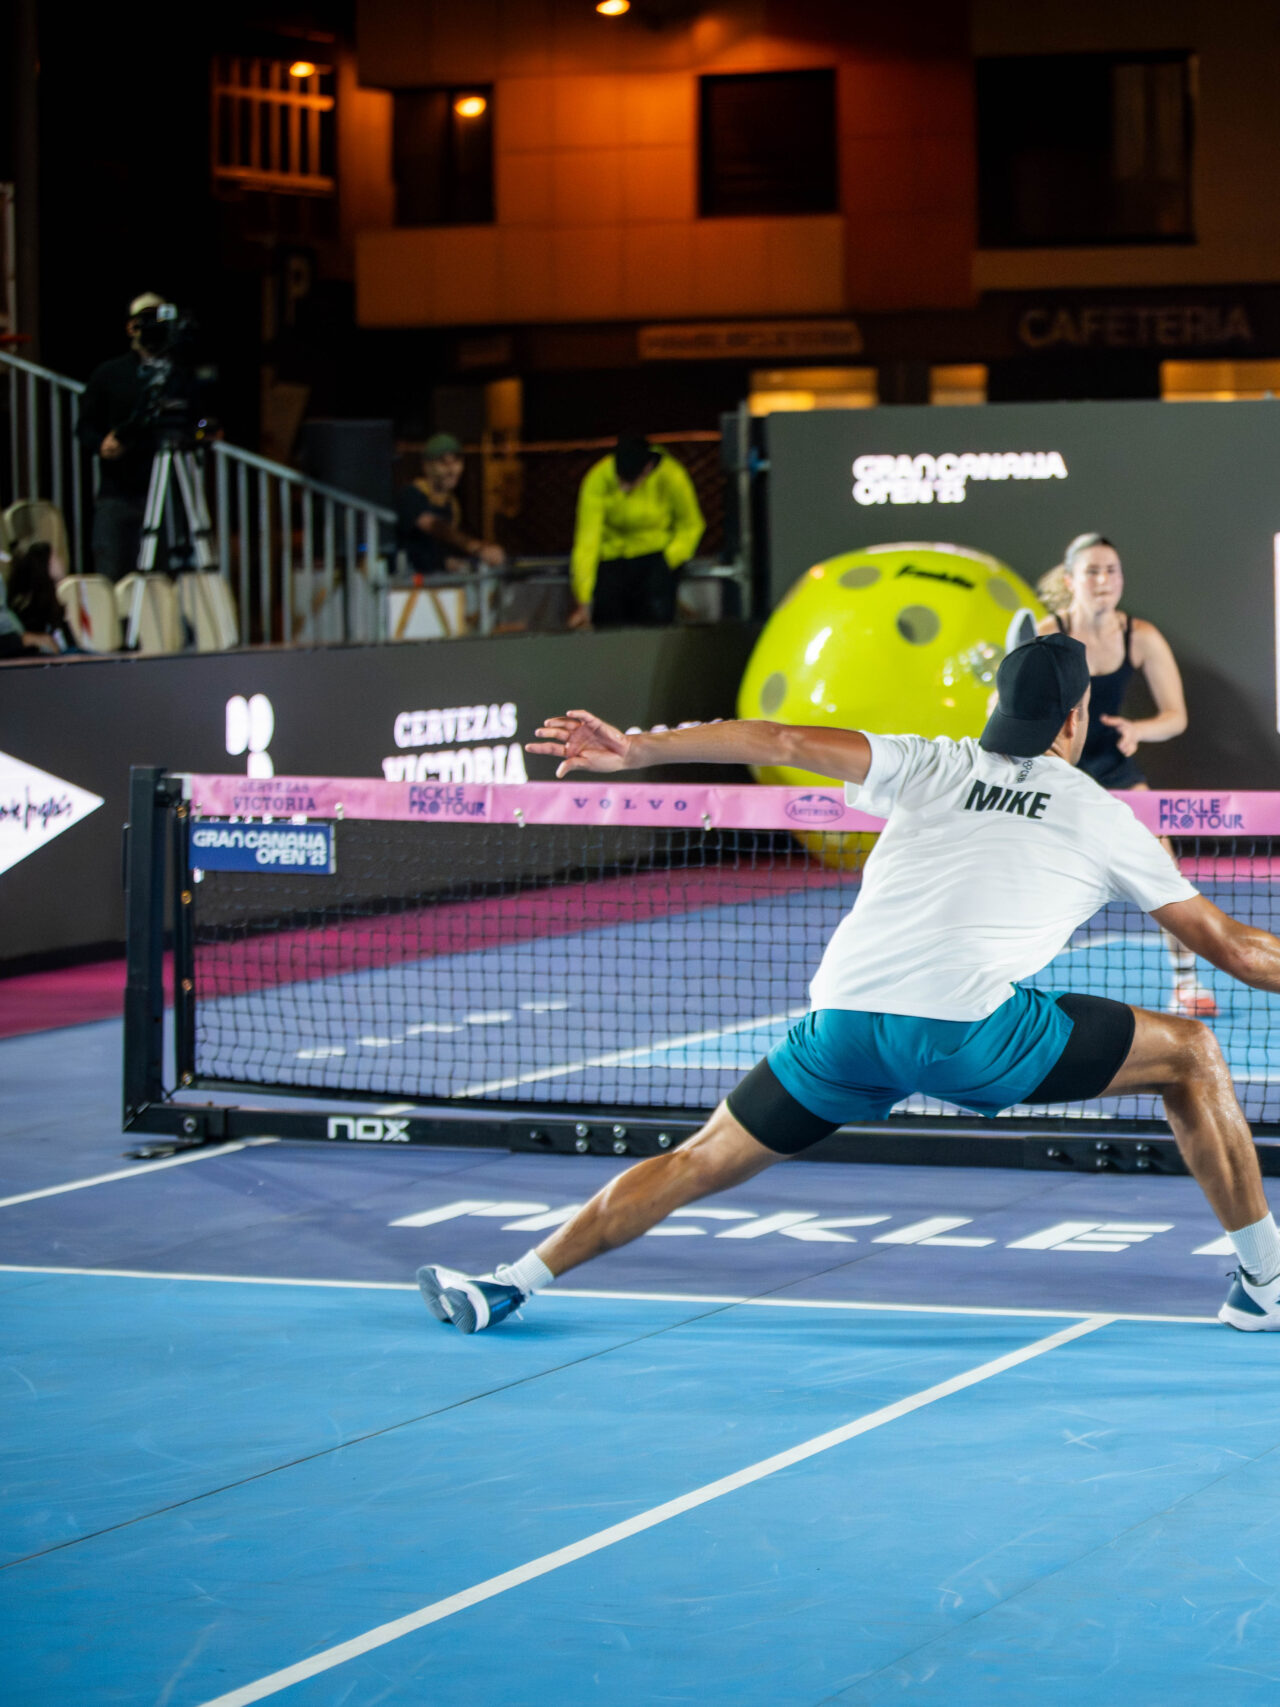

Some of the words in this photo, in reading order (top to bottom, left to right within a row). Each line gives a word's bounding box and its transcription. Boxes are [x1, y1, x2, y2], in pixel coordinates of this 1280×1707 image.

[1018, 303, 1252, 350] CAFETERIA
[394, 702, 518, 748] CERVEZAS
[382, 742, 528, 783] VICTORIA
[409, 786, 465, 801] PICKLE
[964, 780, 1051, 819] MIKE
[232, 797, 317, 811] VICTORIA
[573, 798, 688, 811] VOLVO
[1159, 799, 1221, 815] PICKLE
[192, 829, 244, 849] GRAN
[255, 848, 306, 865] OPEN
